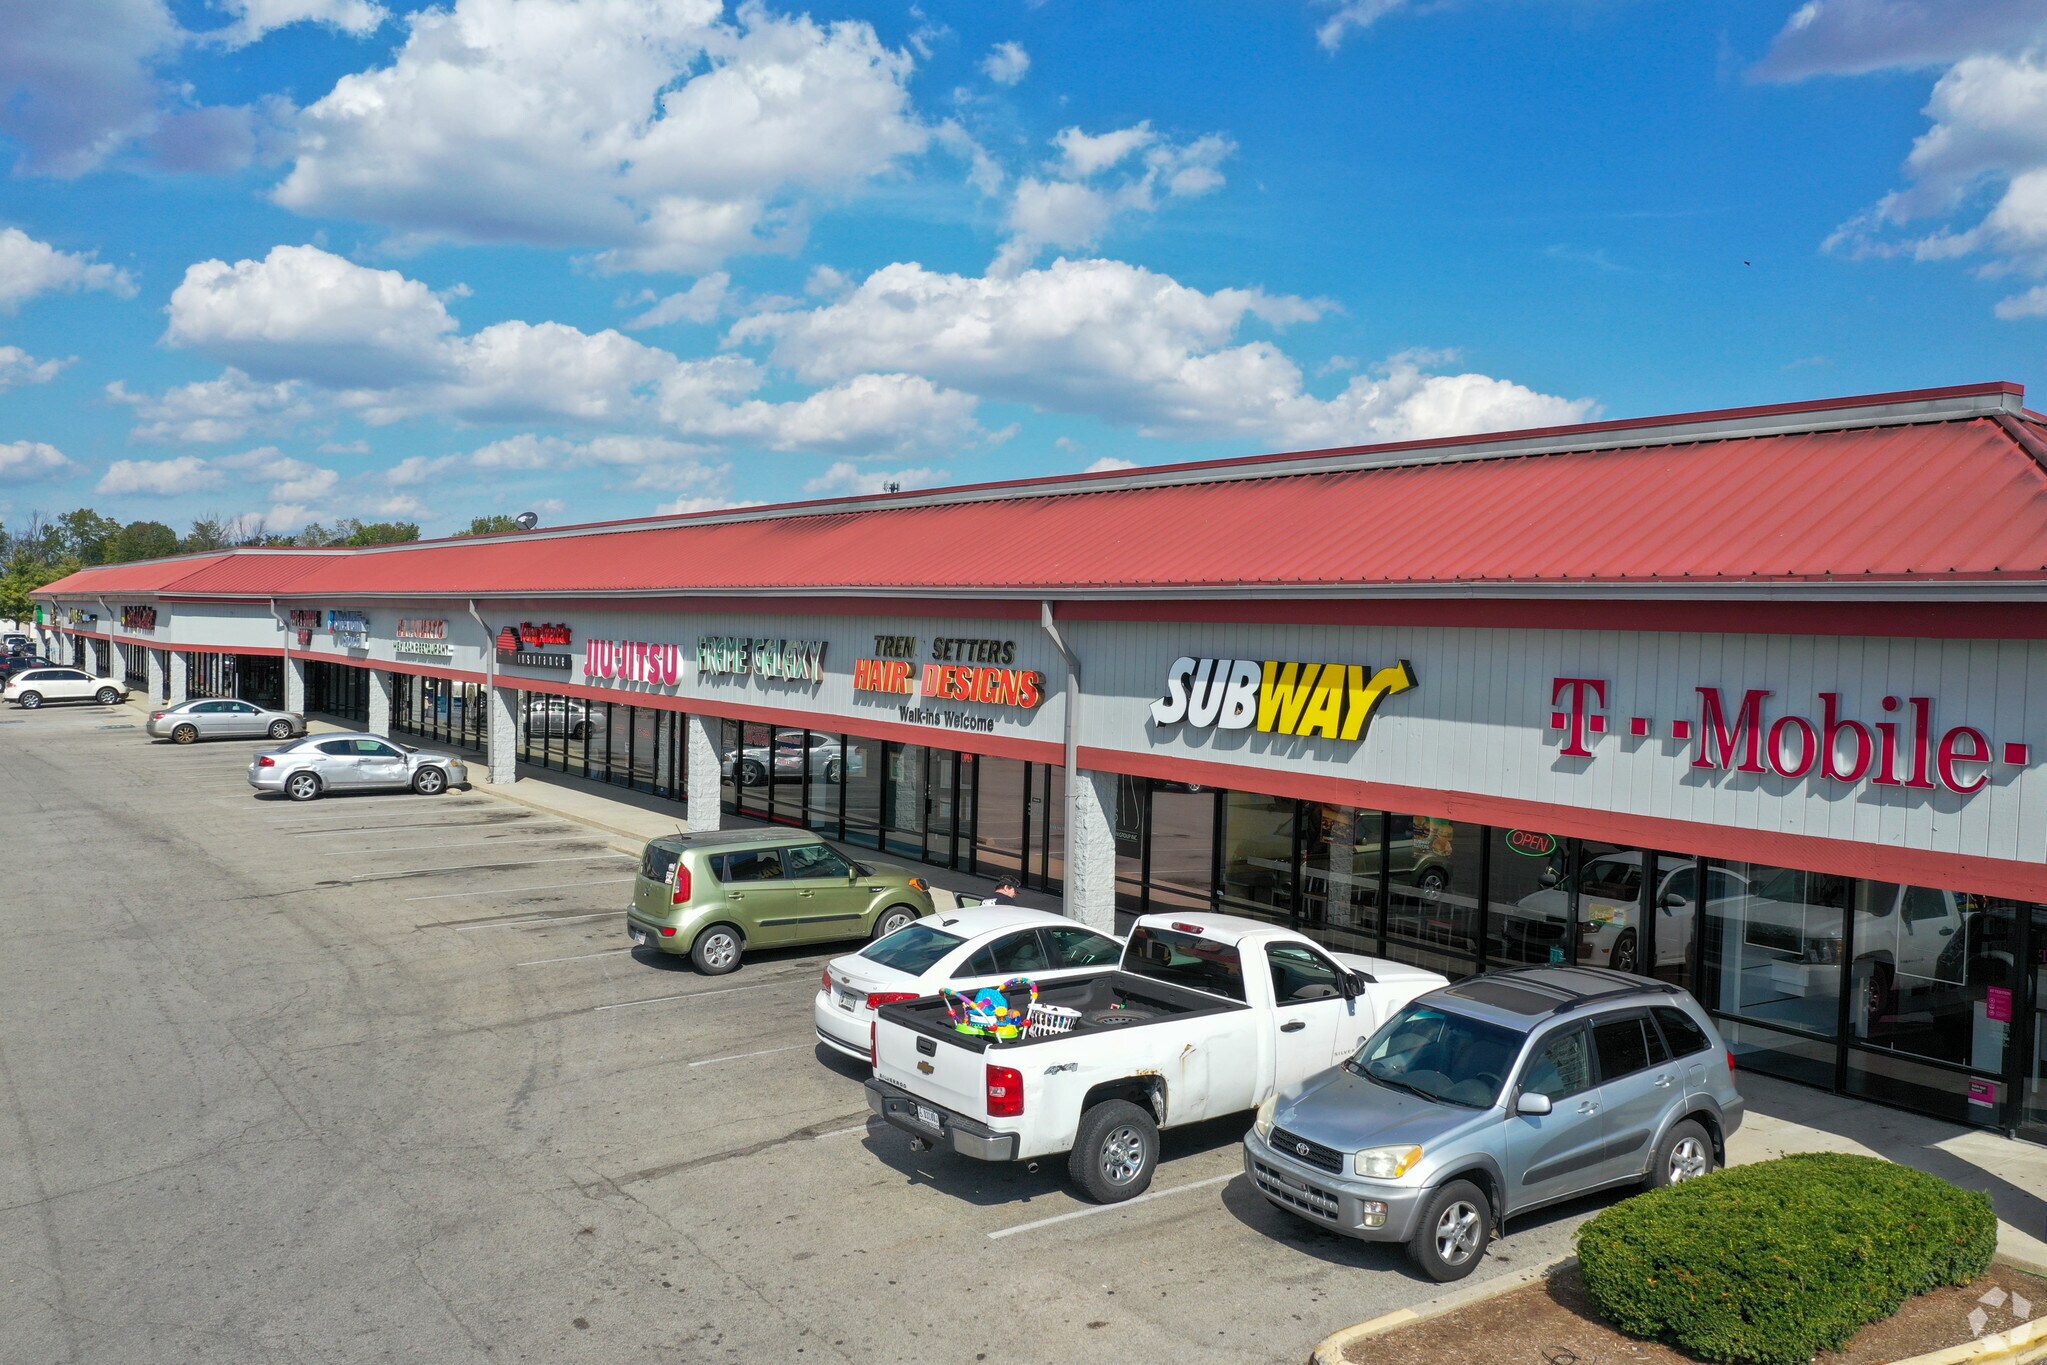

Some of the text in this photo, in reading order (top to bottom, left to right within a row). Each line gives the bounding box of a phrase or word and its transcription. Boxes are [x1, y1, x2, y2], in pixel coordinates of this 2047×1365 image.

[583, 638, 681, 687] JIU-JITSU
[697, 636, 825, 685] FRAME GALAXY
[874, 635, 1017, 665] TREN SETTERS
[853, 659, 1042, 709] HAIR DESIGNS
[1150, 656, 1415, 741] SUBWAY
[900, 706, 994, 732] Walk-ins Welcome
[1512, 831, 1549, 852] OPEN
